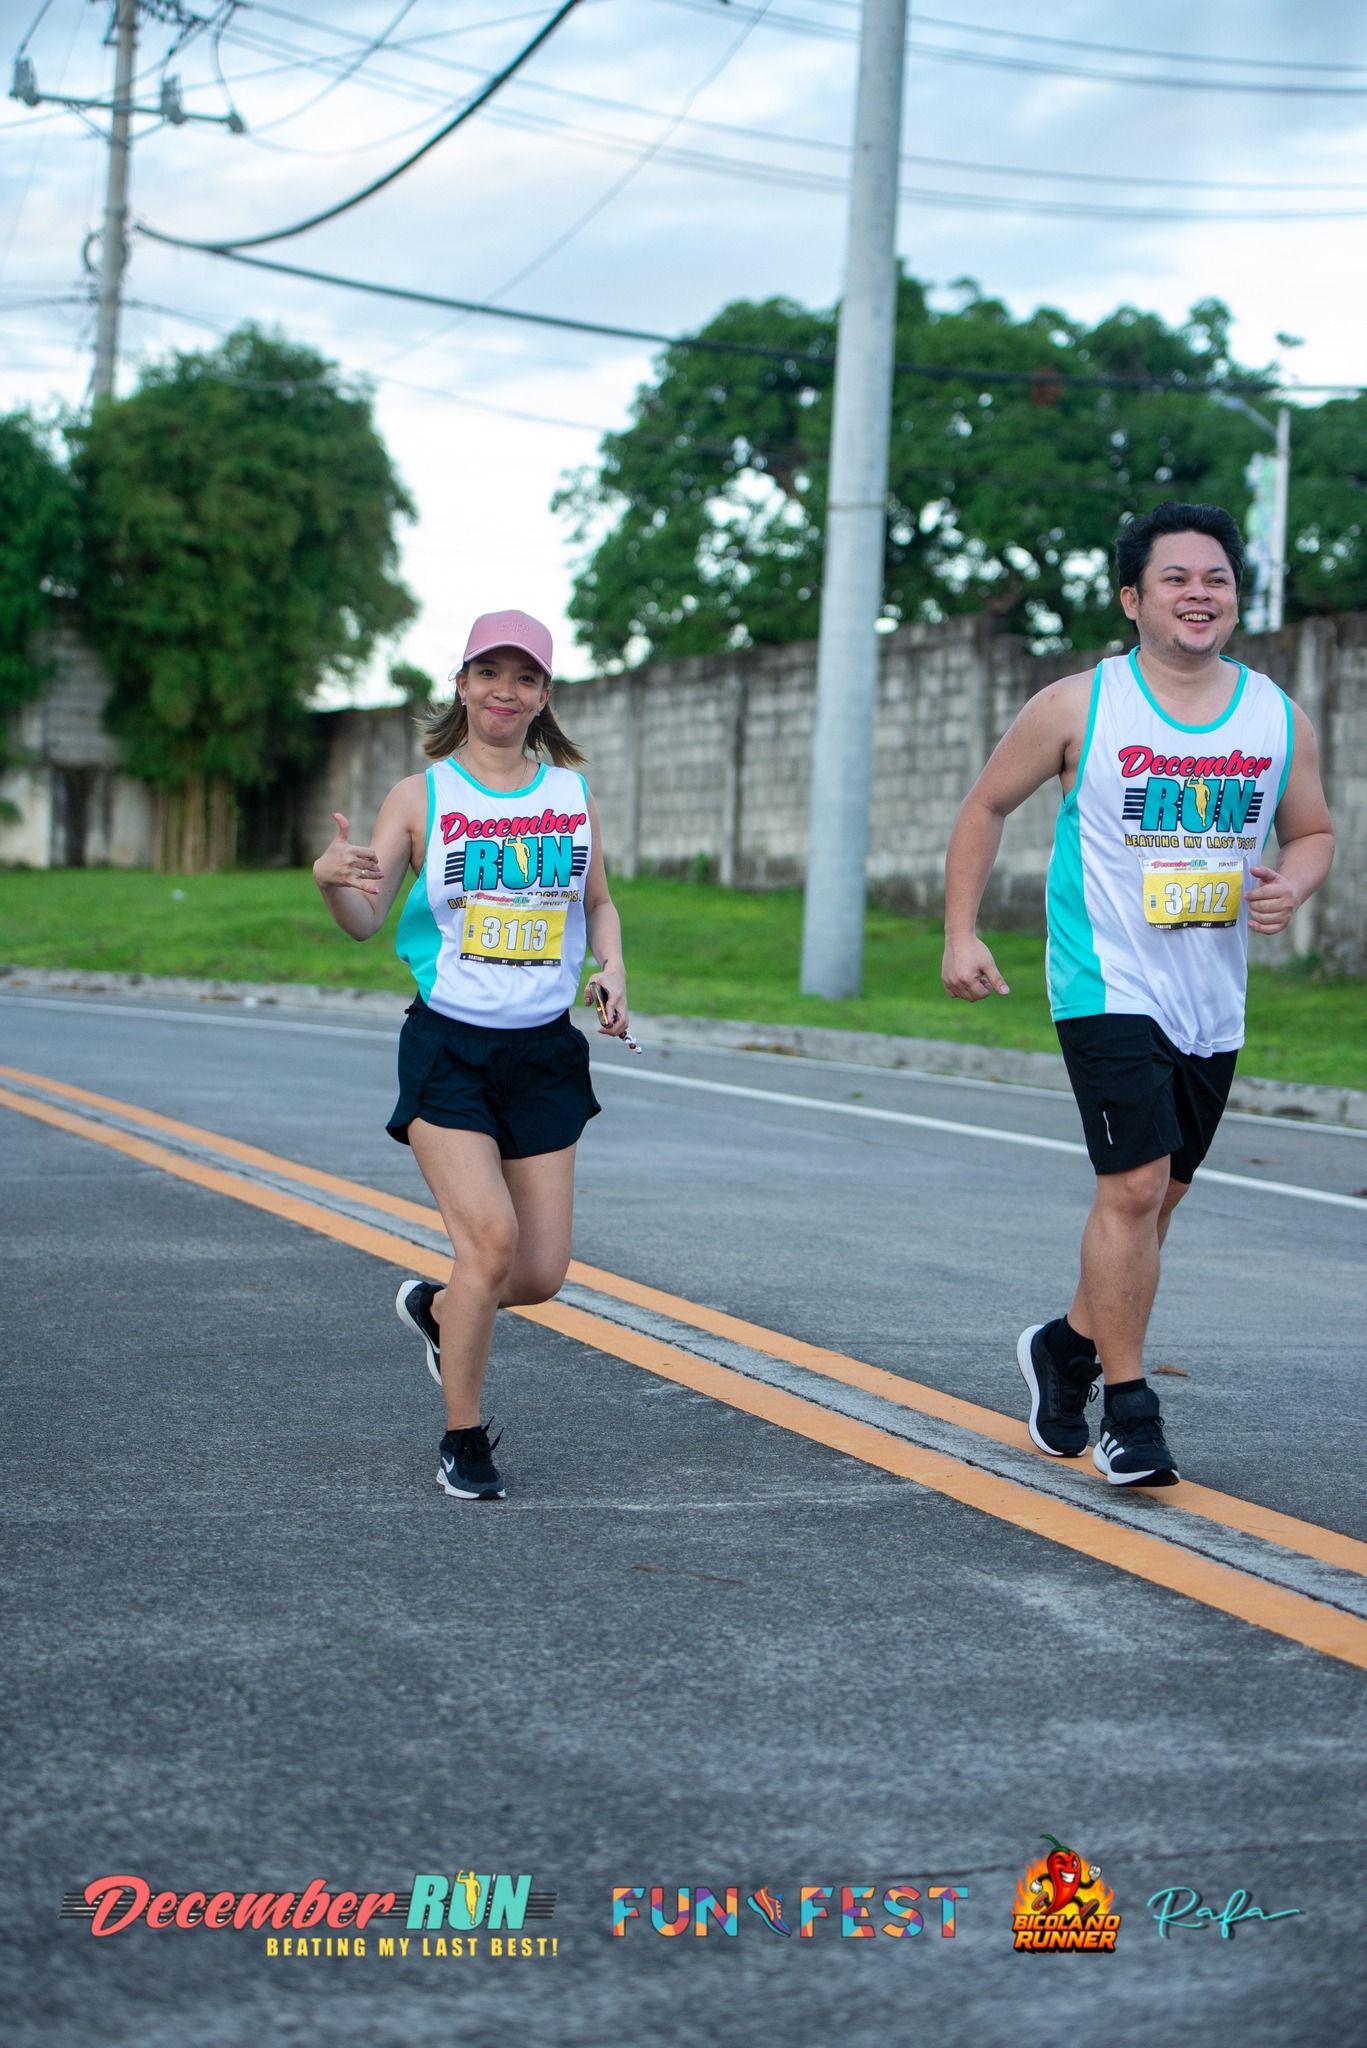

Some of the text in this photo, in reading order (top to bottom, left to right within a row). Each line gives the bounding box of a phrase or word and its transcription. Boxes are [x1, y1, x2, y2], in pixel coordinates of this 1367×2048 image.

[1118, 745, 1272, 778] December
[1140, 776, 1257, 834] RUN
[440, 808, 586, 845] December
[1184, 835, 1202, 848] MY
[1207, 836, 1235, 849] LAST
[462, 835, 573, 891] RUN
[1164, 881, 1229, 916] 3112
[480, 916, 548, 951] 3113
